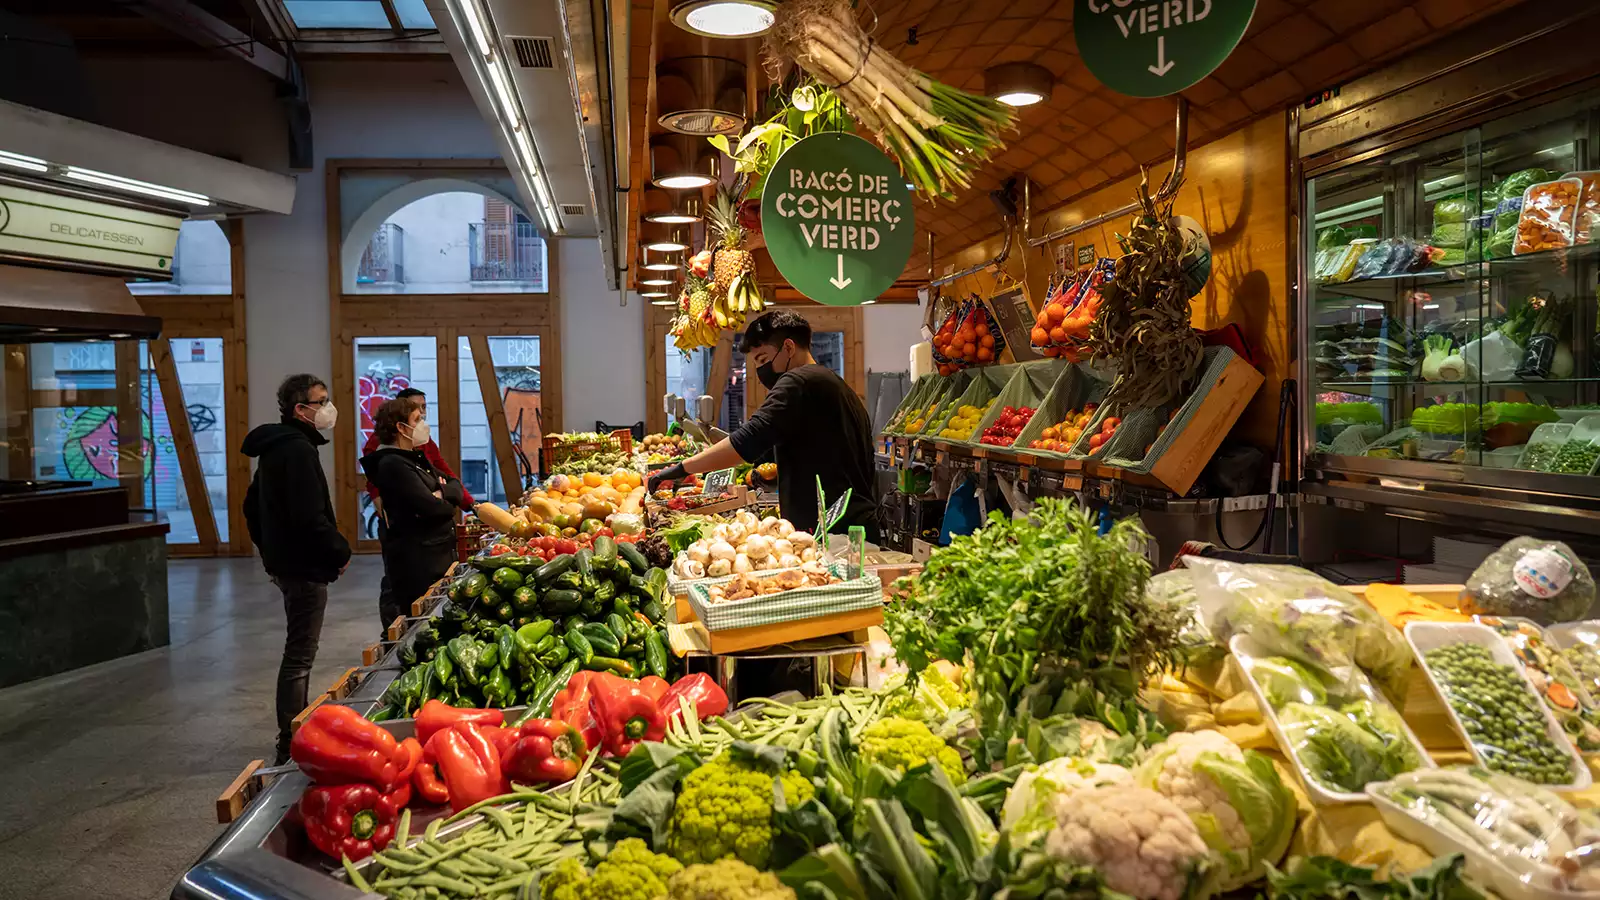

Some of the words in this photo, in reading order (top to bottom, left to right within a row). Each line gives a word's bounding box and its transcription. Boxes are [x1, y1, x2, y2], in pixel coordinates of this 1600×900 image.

[1113, 0, 1212, 38] VERD
[790, 168, 853, 192] RACÓ
[859, 174, 889, 195] DE
[776, 192, 901, 231] COMERÇ
[50, 222, 144, 246] DELICATESSEN
[799, 223, 880, 250] VERD
